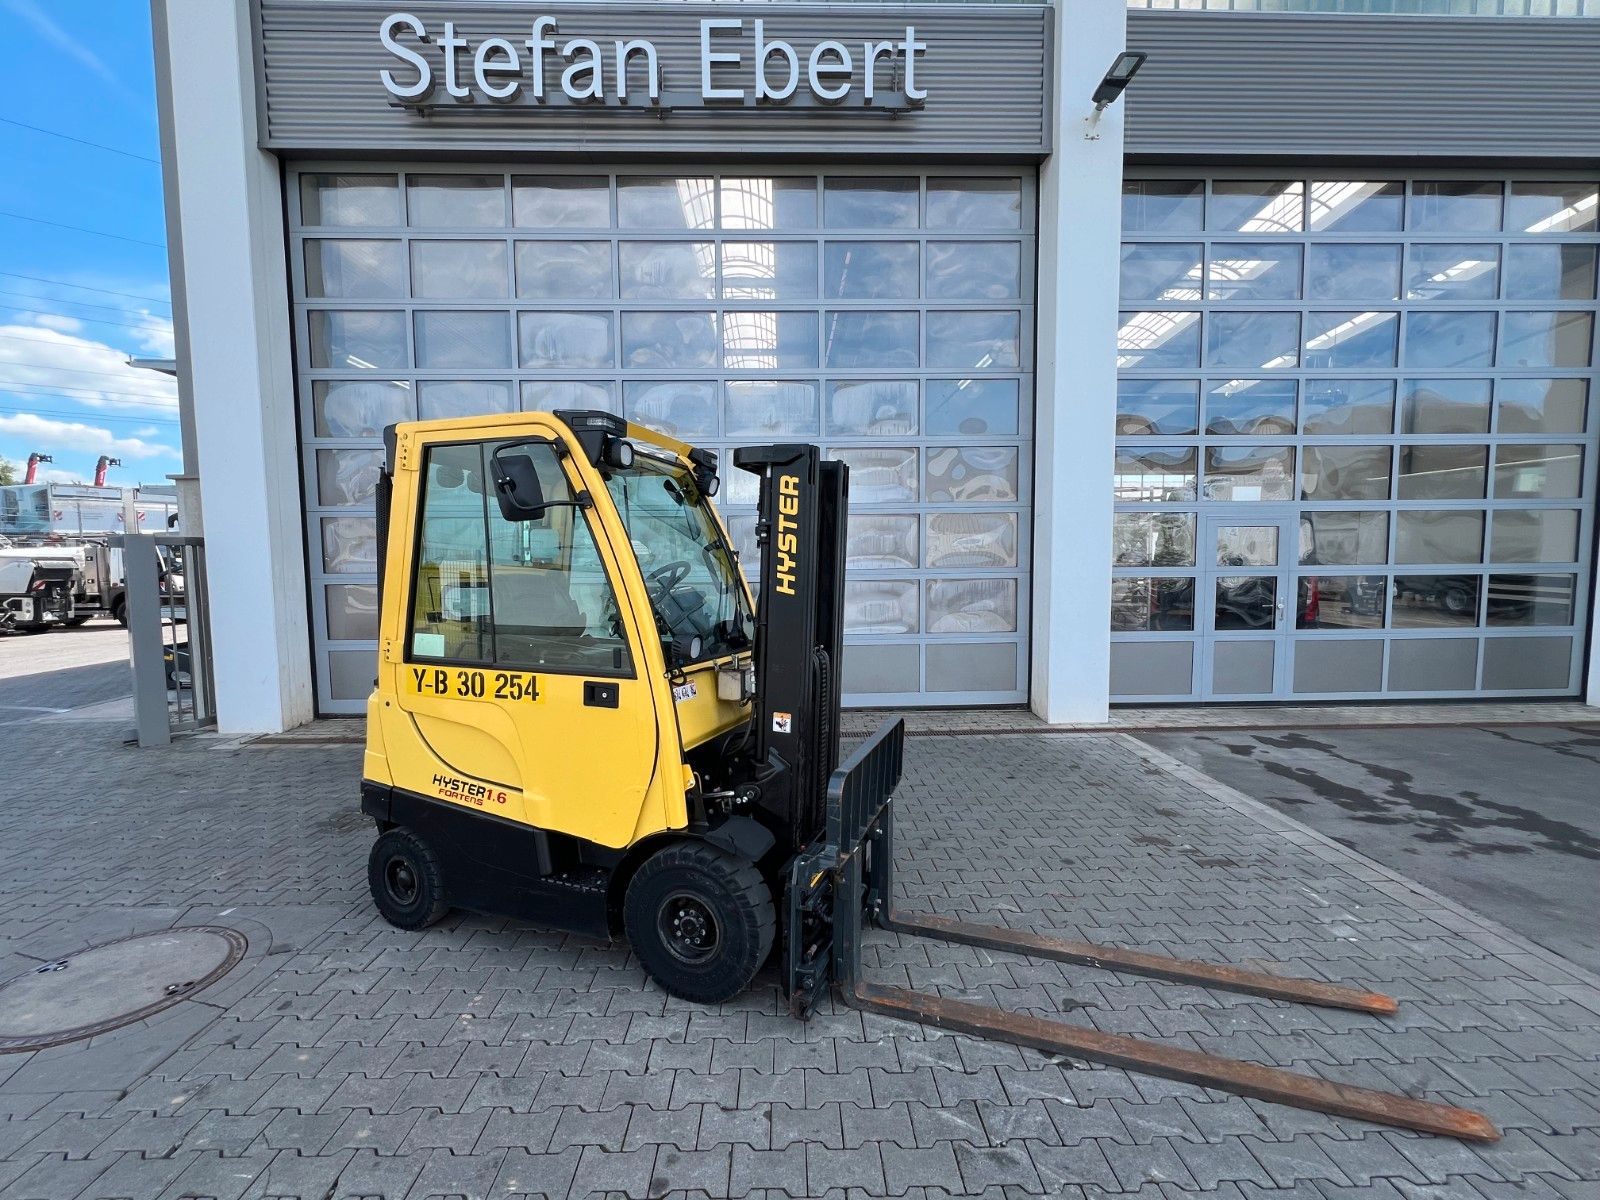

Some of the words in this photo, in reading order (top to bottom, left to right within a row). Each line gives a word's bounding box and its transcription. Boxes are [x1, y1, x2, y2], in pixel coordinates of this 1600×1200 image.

[379, 12, 660, 101] Stefan
[699, 18, 928, 101] Ebert
[776, 474, 800, 595] HYSTER
[412, 668, 449, 695] Y-B
[456, 671, 485, 698] 30
[494, 673, 540, 701] 254
[432, 773, 487, 799] HYSTER
[486, 789, 507, 804] 1.6
[438, 788, 484, 806] FORTENS
